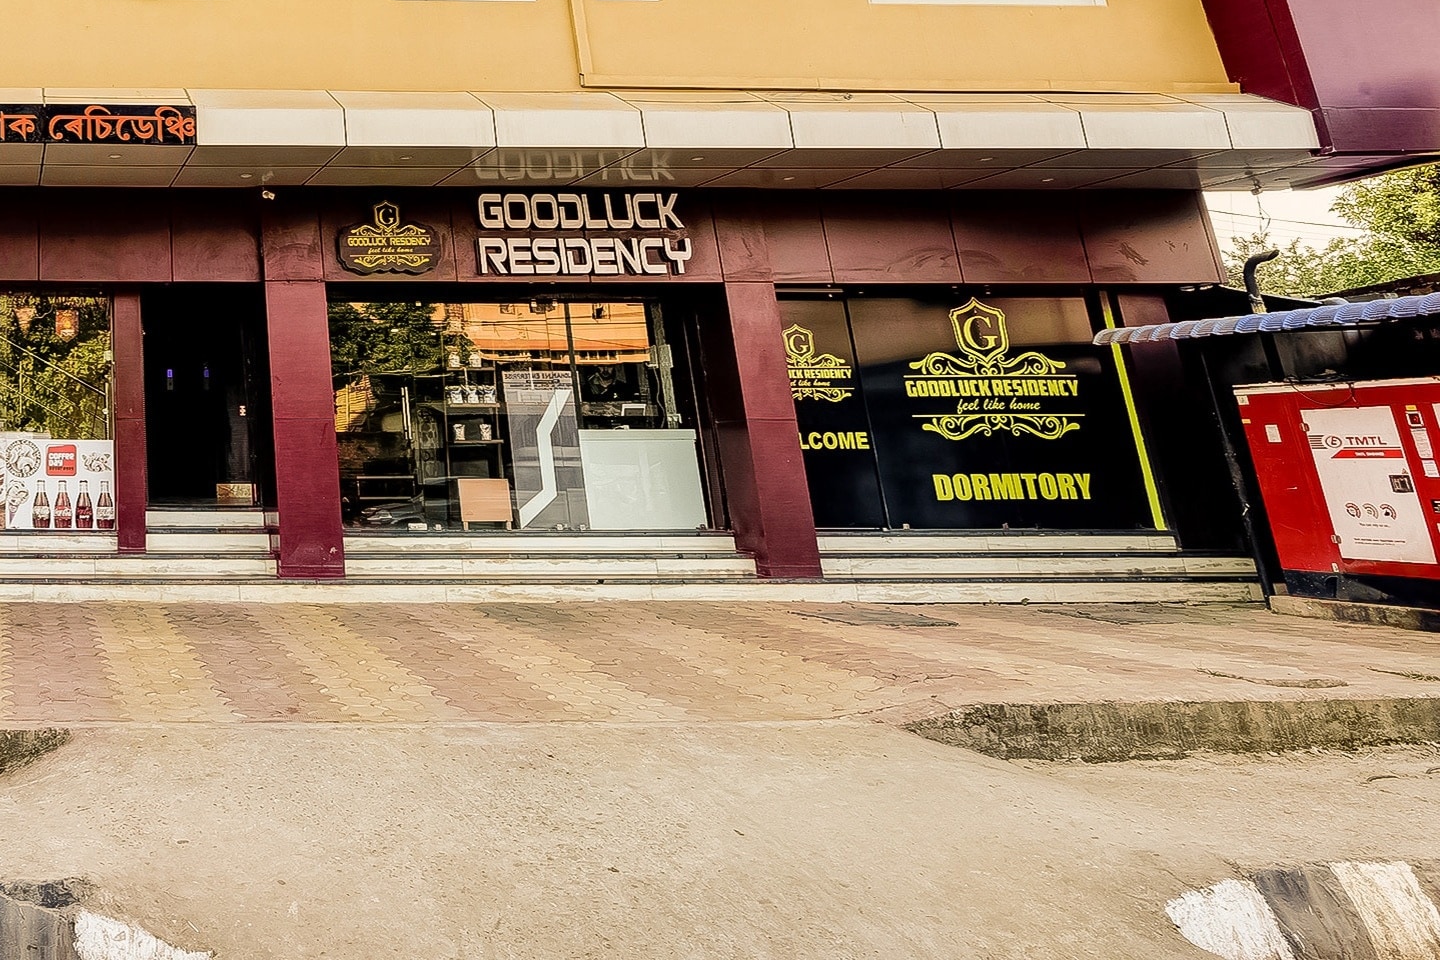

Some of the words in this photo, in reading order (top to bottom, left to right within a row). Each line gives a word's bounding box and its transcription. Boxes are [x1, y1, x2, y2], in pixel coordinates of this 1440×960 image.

[378, 208, 395, 225] G
[478, 193, 685, 230] GOODLUCK
[347, 237, 388, 247] GOODLUCK
[389, 237, 432, 246] RESIDENCY
[367, 246, 381, 255] feel
[477, 237, 694, 275] RESIDENCY
[963, 315, 998, 351] G
[788, 333, 809, 354] G
[803, 369, 852, 379] RESIDENCY
[905, 380, 991, 397] GOODLUCK
[991, 380, 1078, 397] RESIDENCY
[957, 399, 980, 414] feel
[983, 399, 1006, 411] like
[1010, 398, 1041, 411] home
[1345, 436, 1387, 445] TMTL
[932, 473, 1092, 501] DORMITORY
